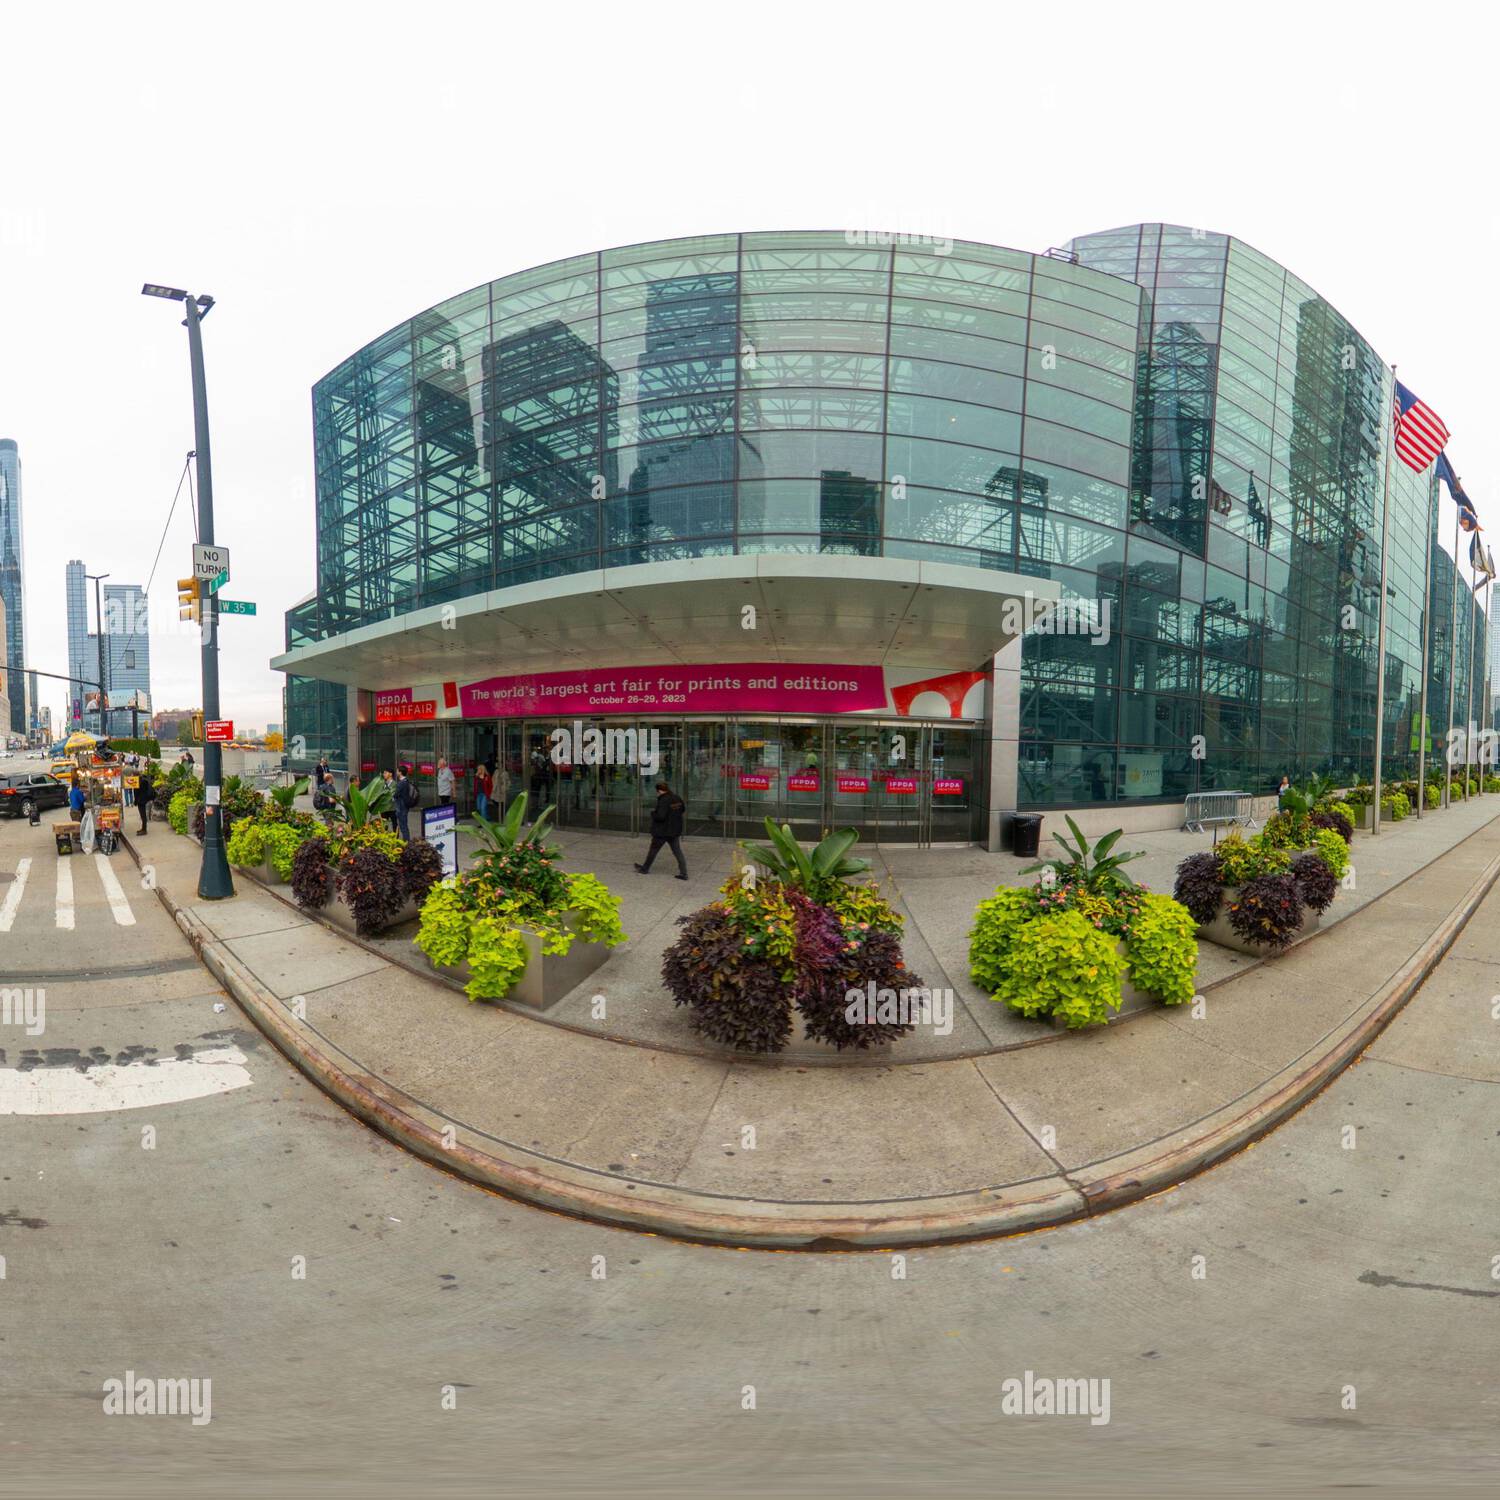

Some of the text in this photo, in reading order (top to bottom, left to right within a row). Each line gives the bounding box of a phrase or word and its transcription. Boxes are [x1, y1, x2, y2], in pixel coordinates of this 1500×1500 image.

[203, 550, 219, 561] NO
[222, 601, 230, 612] W
[233, 602, 246, 614] 35
[471, 676, 859, 700] The world's largest art fair for prints and editions
[589, 695, 624, 705] October
[662, 694, 686, 703] 2023
[378, 703, 433, 717] PRINTFAIR
